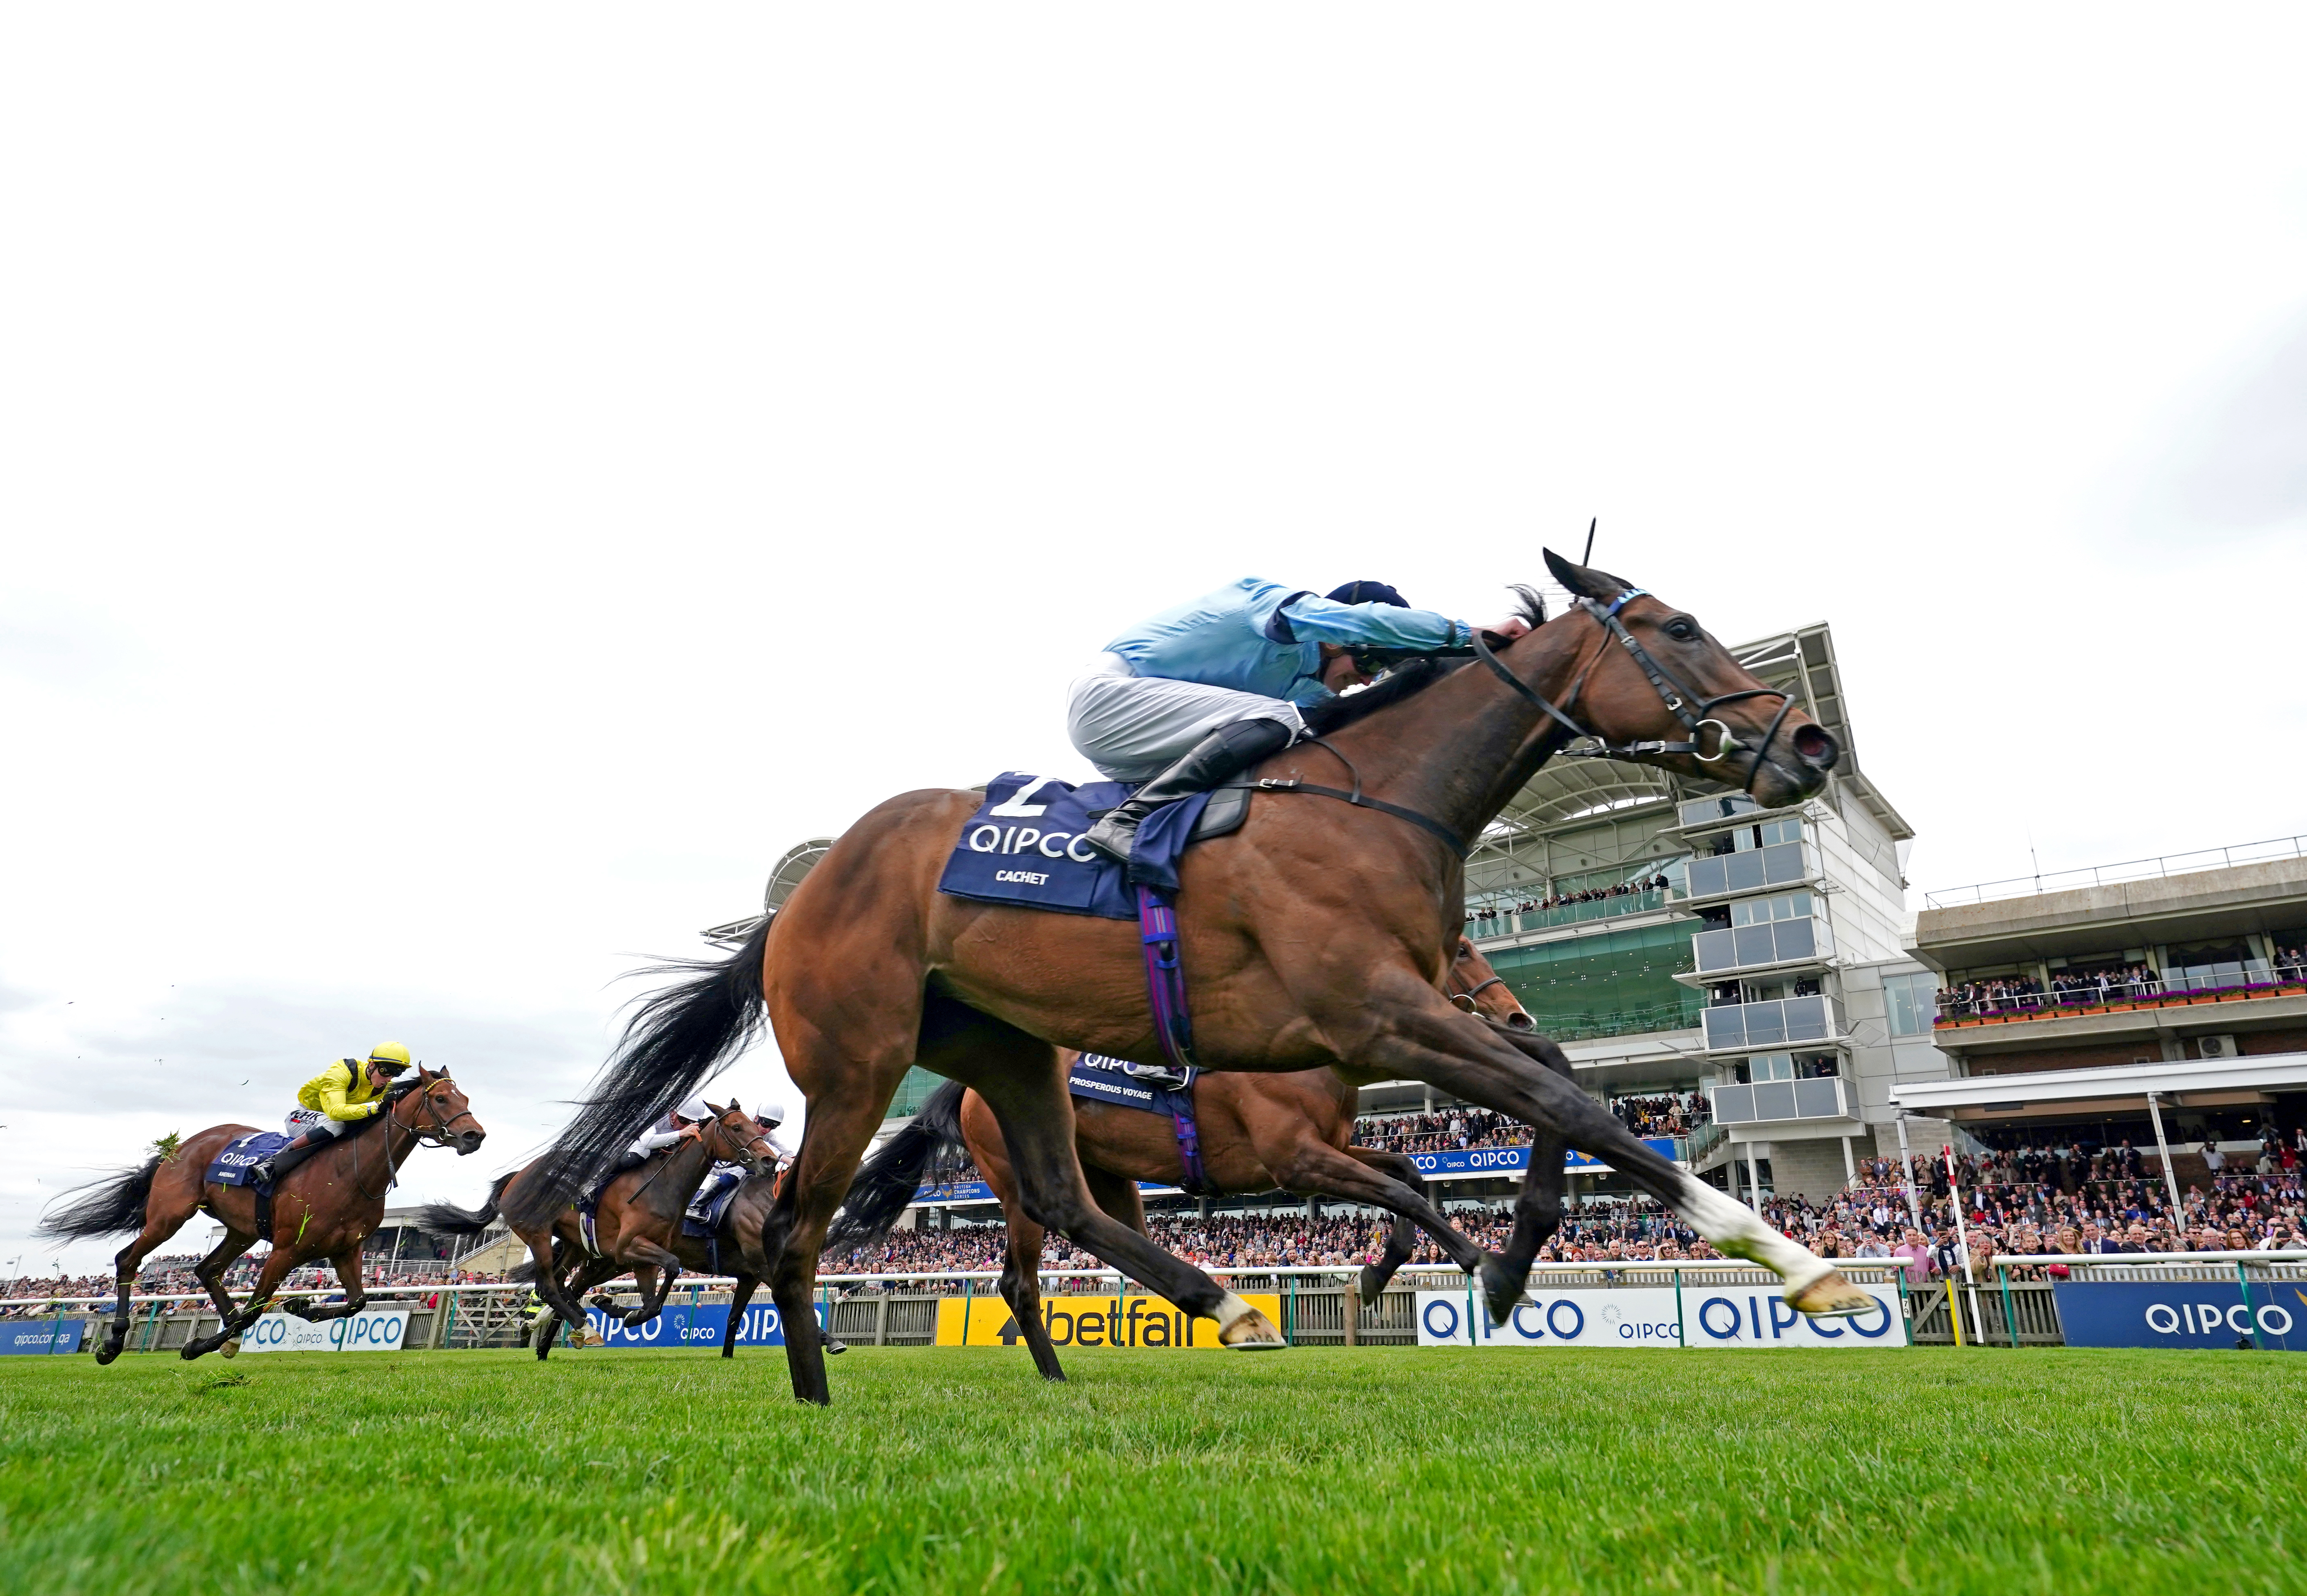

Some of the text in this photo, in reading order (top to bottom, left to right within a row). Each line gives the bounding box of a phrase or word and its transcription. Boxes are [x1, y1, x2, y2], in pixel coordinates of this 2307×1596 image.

[969, 825, 1097, 862] QIPCO
[995, 870, 1049, 885] CACHET
[1084, 1053, 1134, 1075] QIPC
[1069, 1076, 1152, 1100] PROSPEROUS VOYAGE
[238, 1132, 266, 1147] 1
[221, 1152, 258, 1166] QIPCO
[1470, 1151, 1519, 1167] QIPCO
[1046, 1300, 1207, 1346] betfair
[2145, 1304, 2293, 1335] QIPCO
[297, 1334, 322, 1343] QIPCO
[330, 1317, 401, 1344] QIPCO
[680, 1328, 715, 1339] QIPCO
[1619, 1323, 1680, 1340] QIPCO
